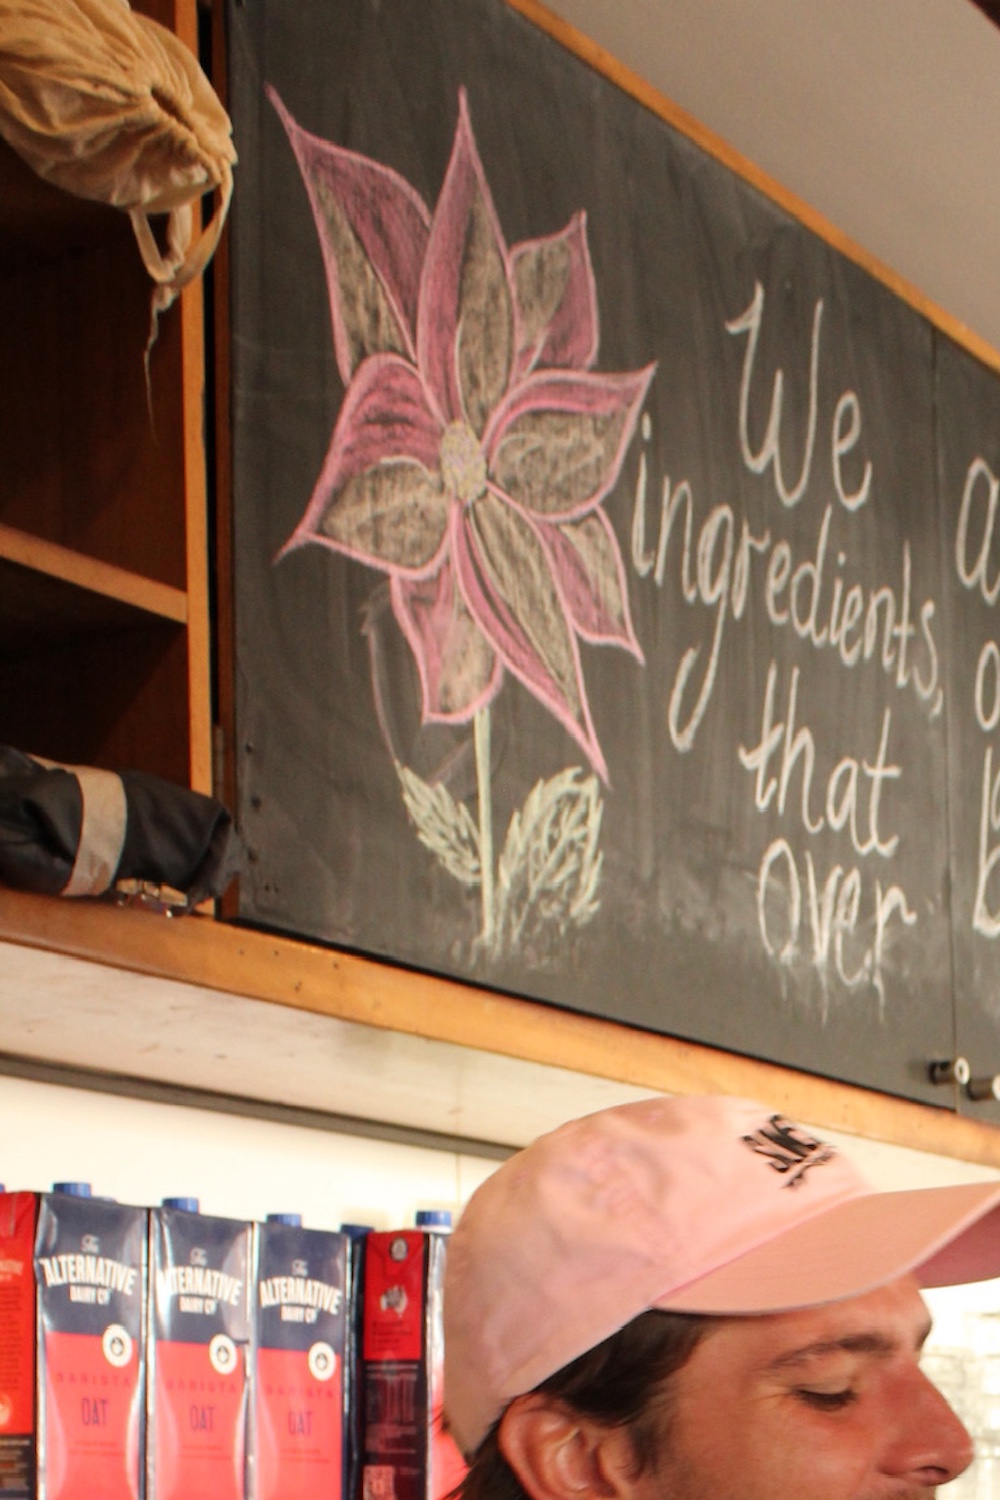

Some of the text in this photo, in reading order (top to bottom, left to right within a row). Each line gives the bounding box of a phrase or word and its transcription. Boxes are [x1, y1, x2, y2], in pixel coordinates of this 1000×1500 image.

[724, 280, 873, 511] We
[631, 412, 944, 752] ingredients,
[738, 658, 903, 859] that
[42, 1254, 137, 1297] ALTERNATIVE
[260, 1276, 342, 1316] ALTERNATIVE
[265, 1384, 335, 1400] BARSTA
[81, 1398, 109, 1427] OAT
[189, 1404, 216, 1433] OAT
[287, 1410, 315, 1437] OAT
